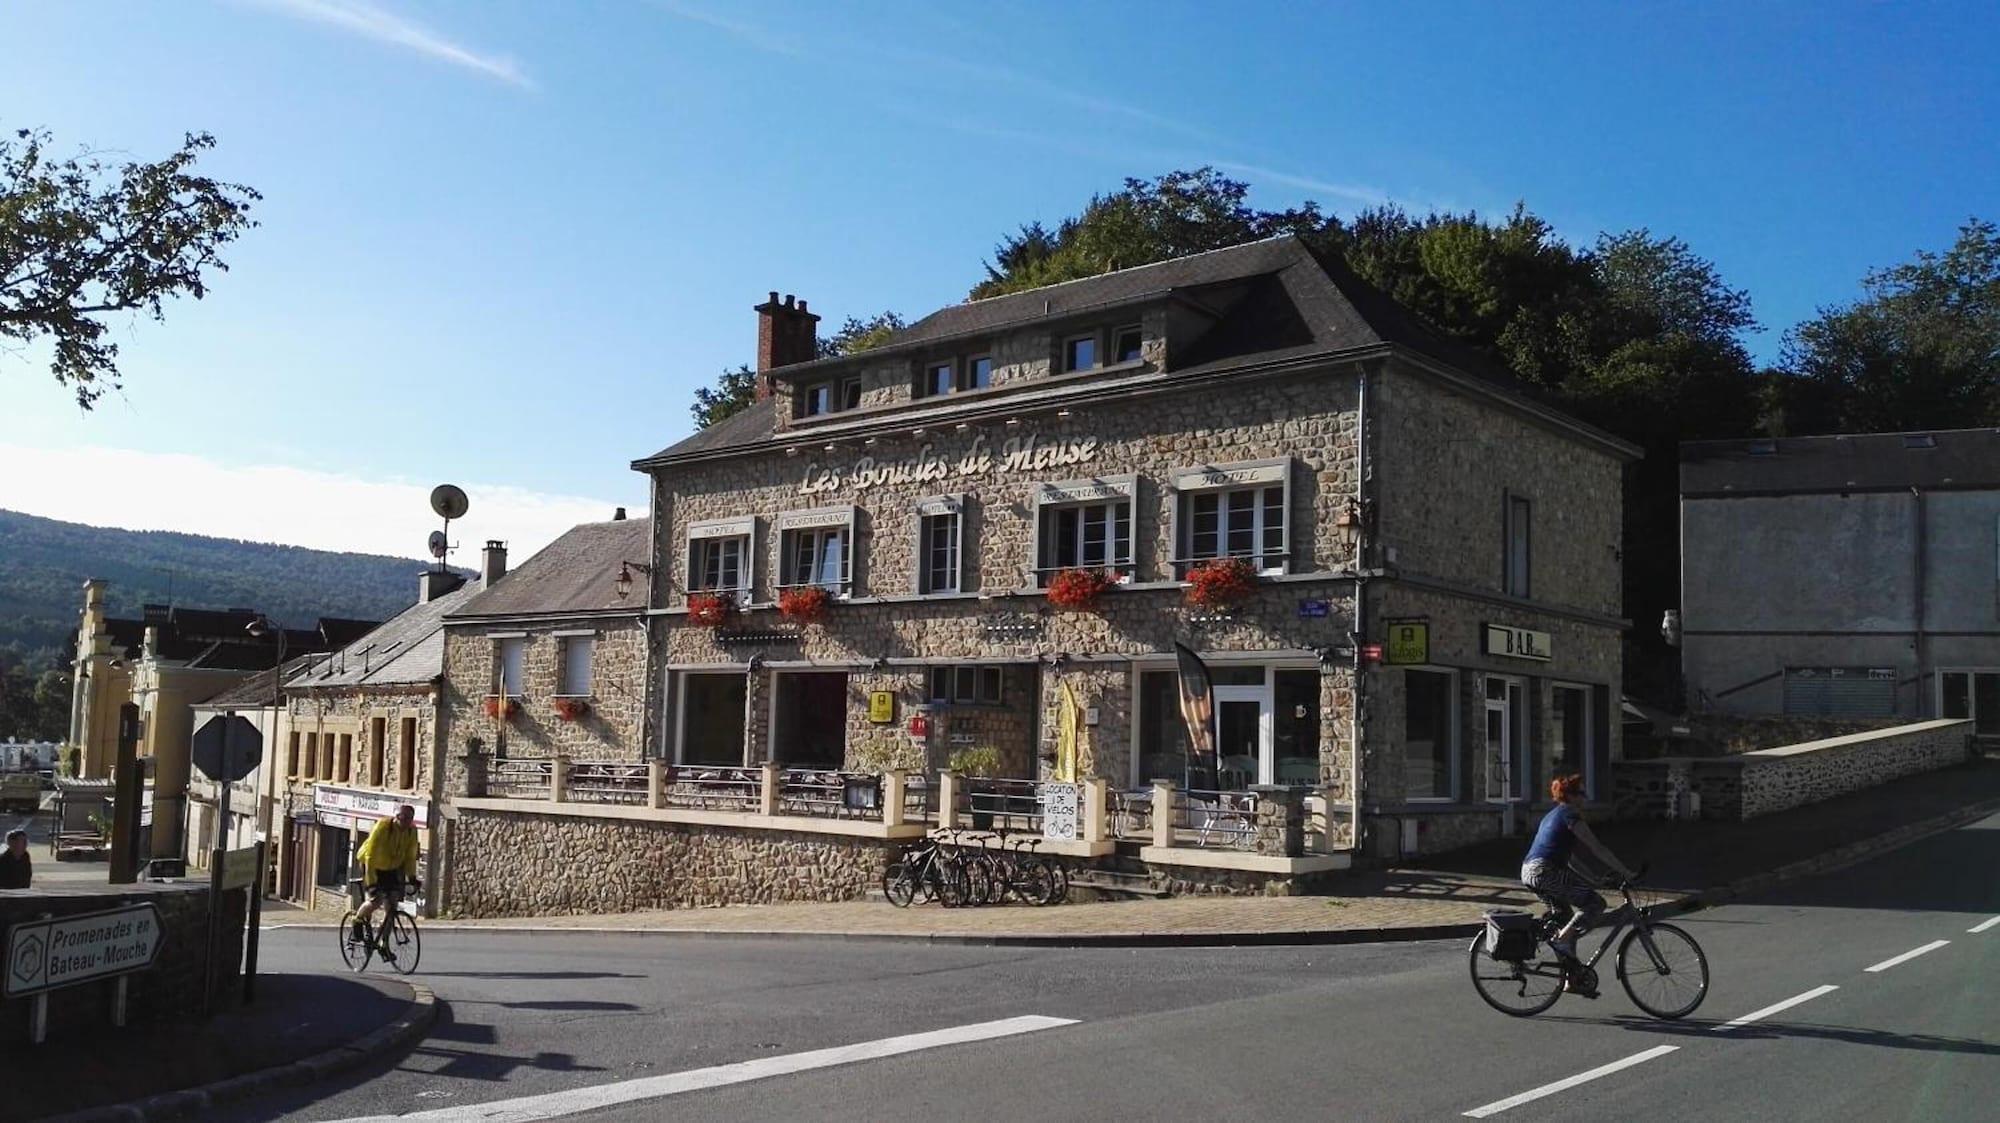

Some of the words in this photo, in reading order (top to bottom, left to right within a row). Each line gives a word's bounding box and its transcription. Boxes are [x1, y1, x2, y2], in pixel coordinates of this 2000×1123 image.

[799, 463, 841, 495] Les
[853, 443, 949, 489] Boucles
[959, 434, 991, 475] de
[999, 432, 1097, 472] Meuse
[785, 512, 848, 528] RESTAURANT
[1507, 629, 1534, 656] BAR
[53, 919, 131, 949] Promenades
[137, 918, 150, 934] en
[50, 940, 148, 976] Bateau-Mouche
